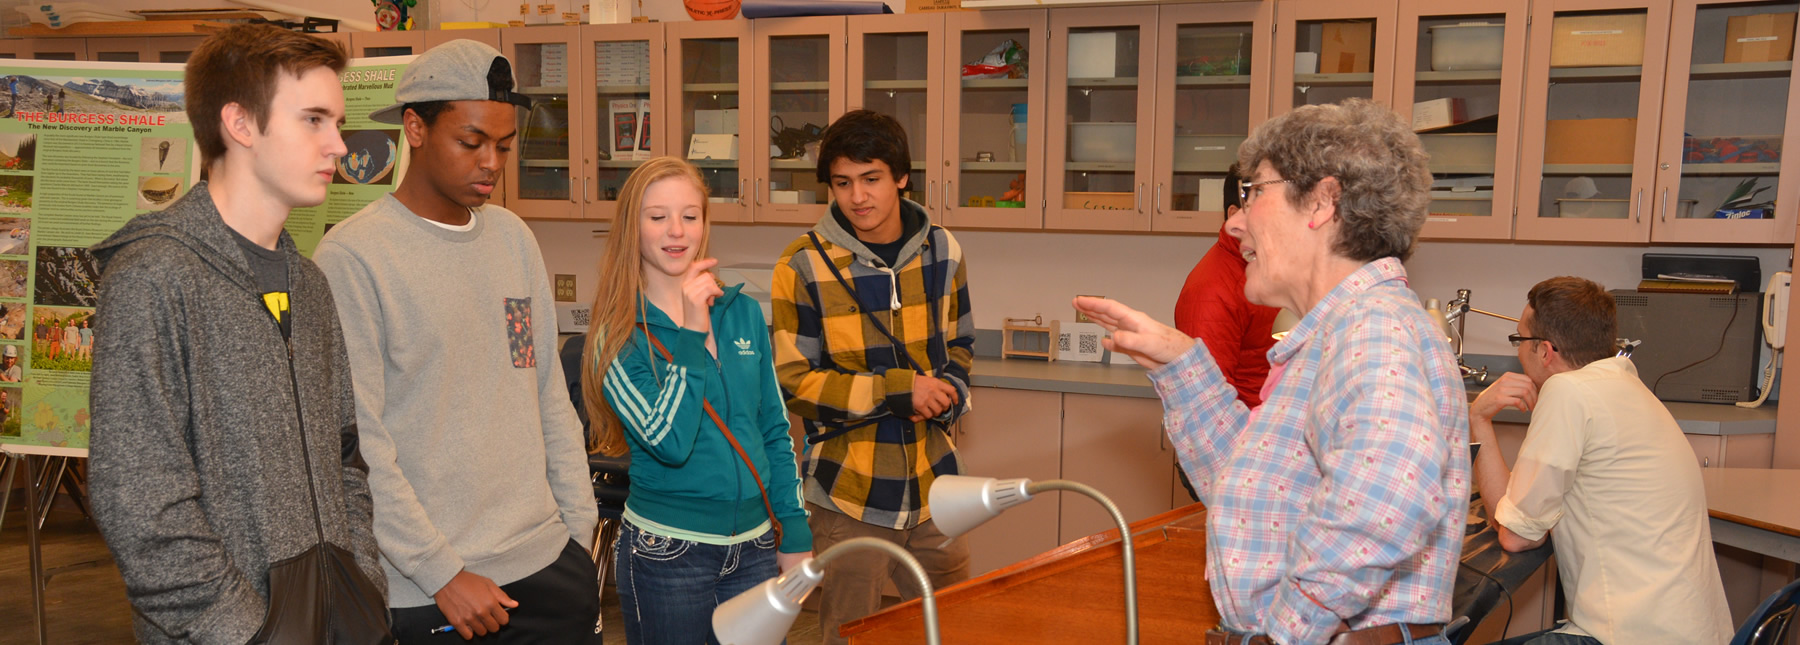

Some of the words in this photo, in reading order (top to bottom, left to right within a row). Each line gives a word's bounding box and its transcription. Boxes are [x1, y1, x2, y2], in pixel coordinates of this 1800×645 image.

[364, 70, 396, 82] SHALE
[16, 112, 44, 123] THE
[49, 113, 115, 125] BURGESS
[120, 115, 166, 126] SHALE
